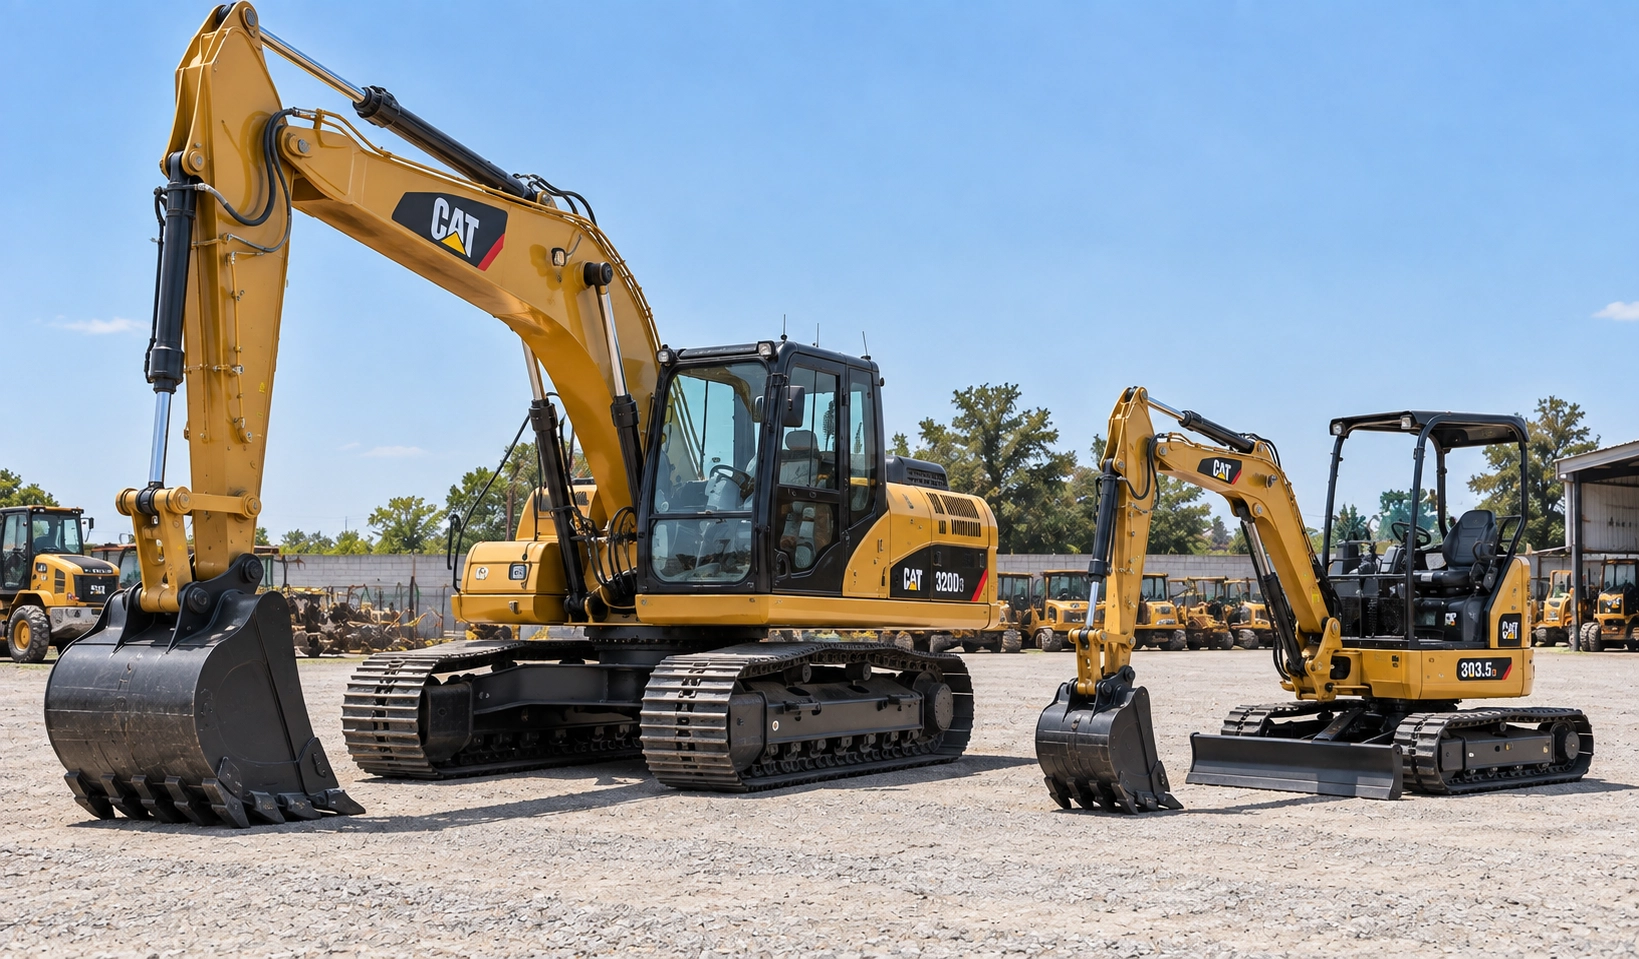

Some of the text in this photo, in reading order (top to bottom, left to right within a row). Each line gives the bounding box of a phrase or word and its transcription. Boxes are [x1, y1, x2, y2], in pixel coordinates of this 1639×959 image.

[431, 197, 479, 258] CAT
[1213, 459, 1231, 481] CAT
[903, 567, 923, 591] CAT
[1502, 621, 1518, 639] CAT
